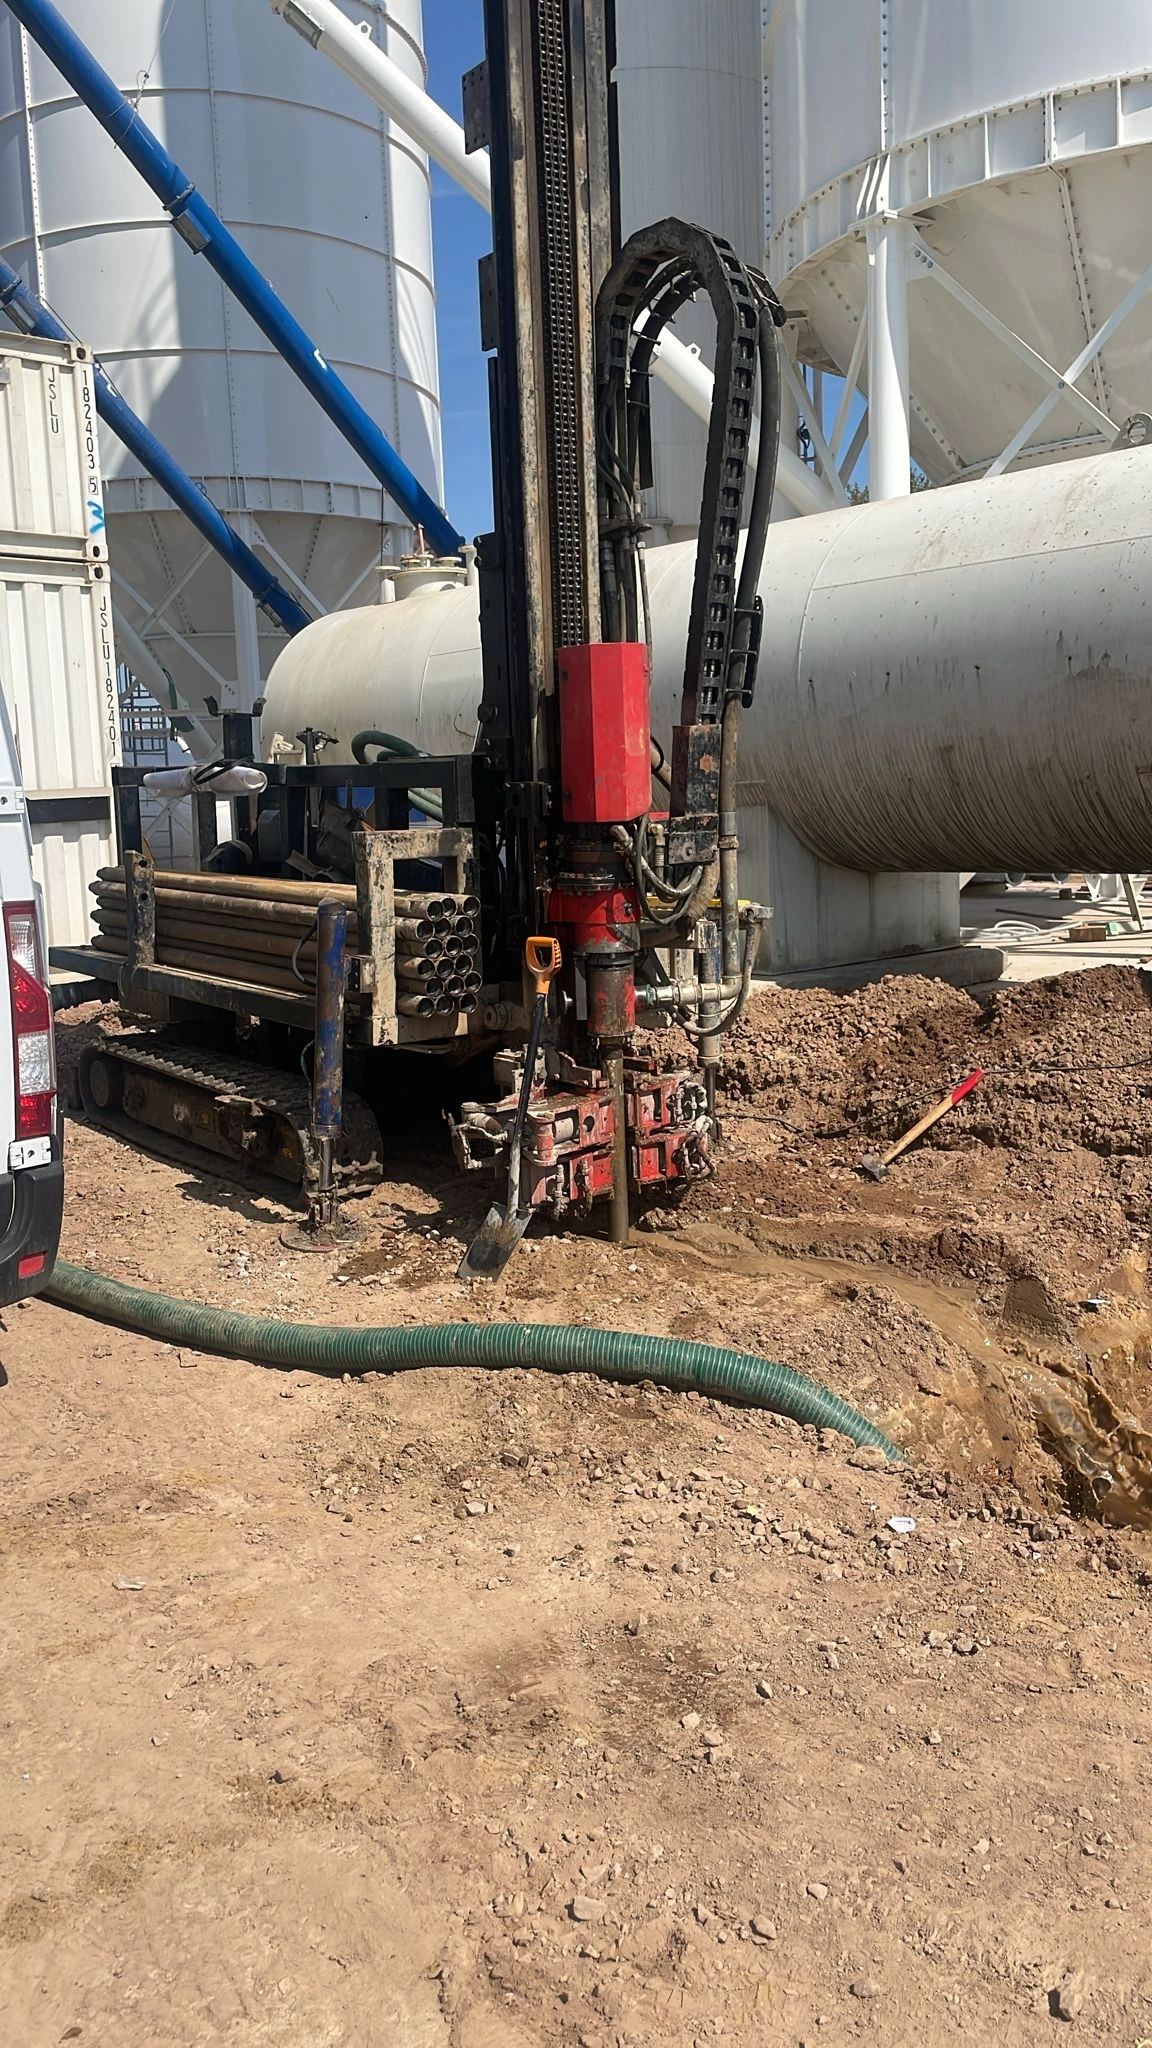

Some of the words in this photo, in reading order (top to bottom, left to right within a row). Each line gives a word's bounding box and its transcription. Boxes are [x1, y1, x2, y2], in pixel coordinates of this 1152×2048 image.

[48, 367, 59, 433] JSLU
[82, 370, 95, 469] 182403
[89, 477, 97, 493] 5
[100, 596, 116, 756] JSLU182401
